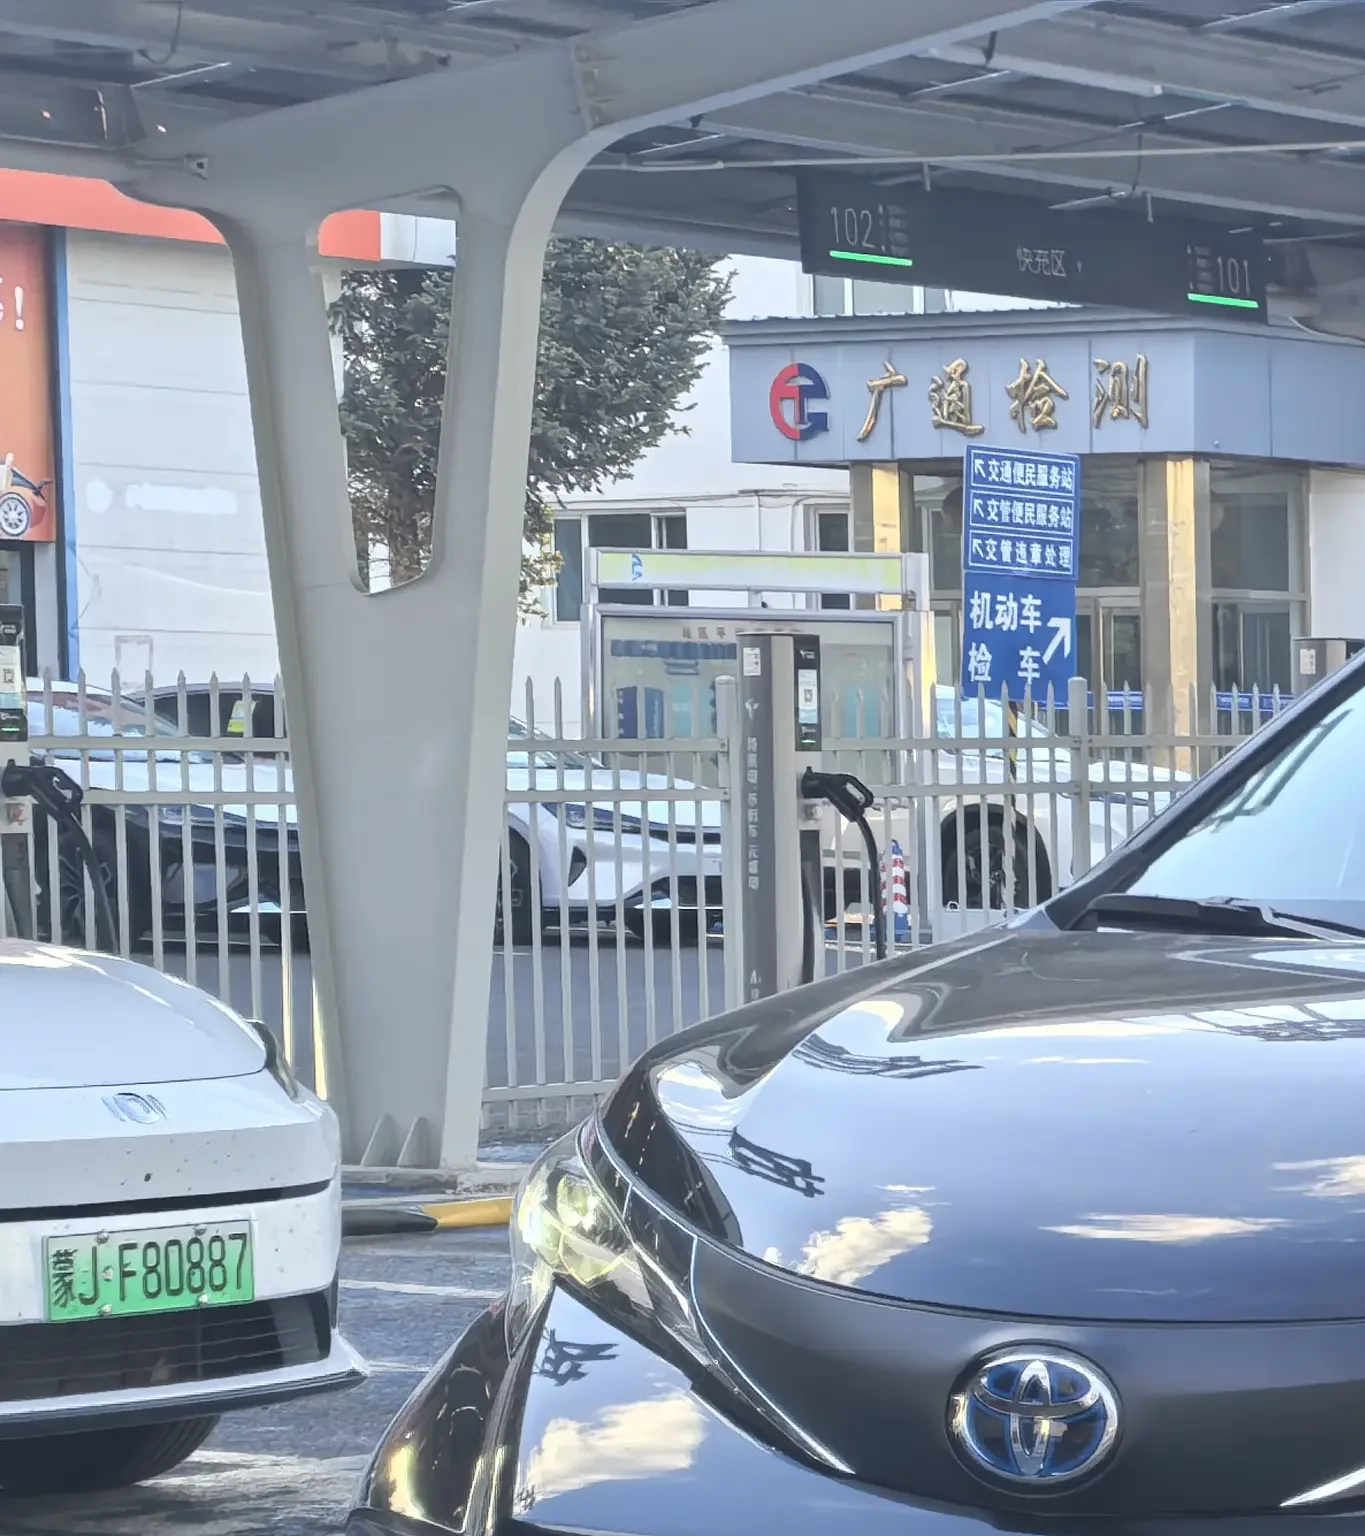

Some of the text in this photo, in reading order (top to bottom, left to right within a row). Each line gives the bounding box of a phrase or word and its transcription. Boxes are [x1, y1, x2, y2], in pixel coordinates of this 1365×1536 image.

[830, 206, 876, 248] 102
[1217, 256, 1250, 296] 101
[856, 352, 1149, 443] 广通检测
[987, 458, 1073, 490] 交通便民服务站
[986, 498, 1072, 528] 交管便民服务站
[985, 537, 1071, 569] 交管违章处理
[970, 590, 1042, 634] 机动车
